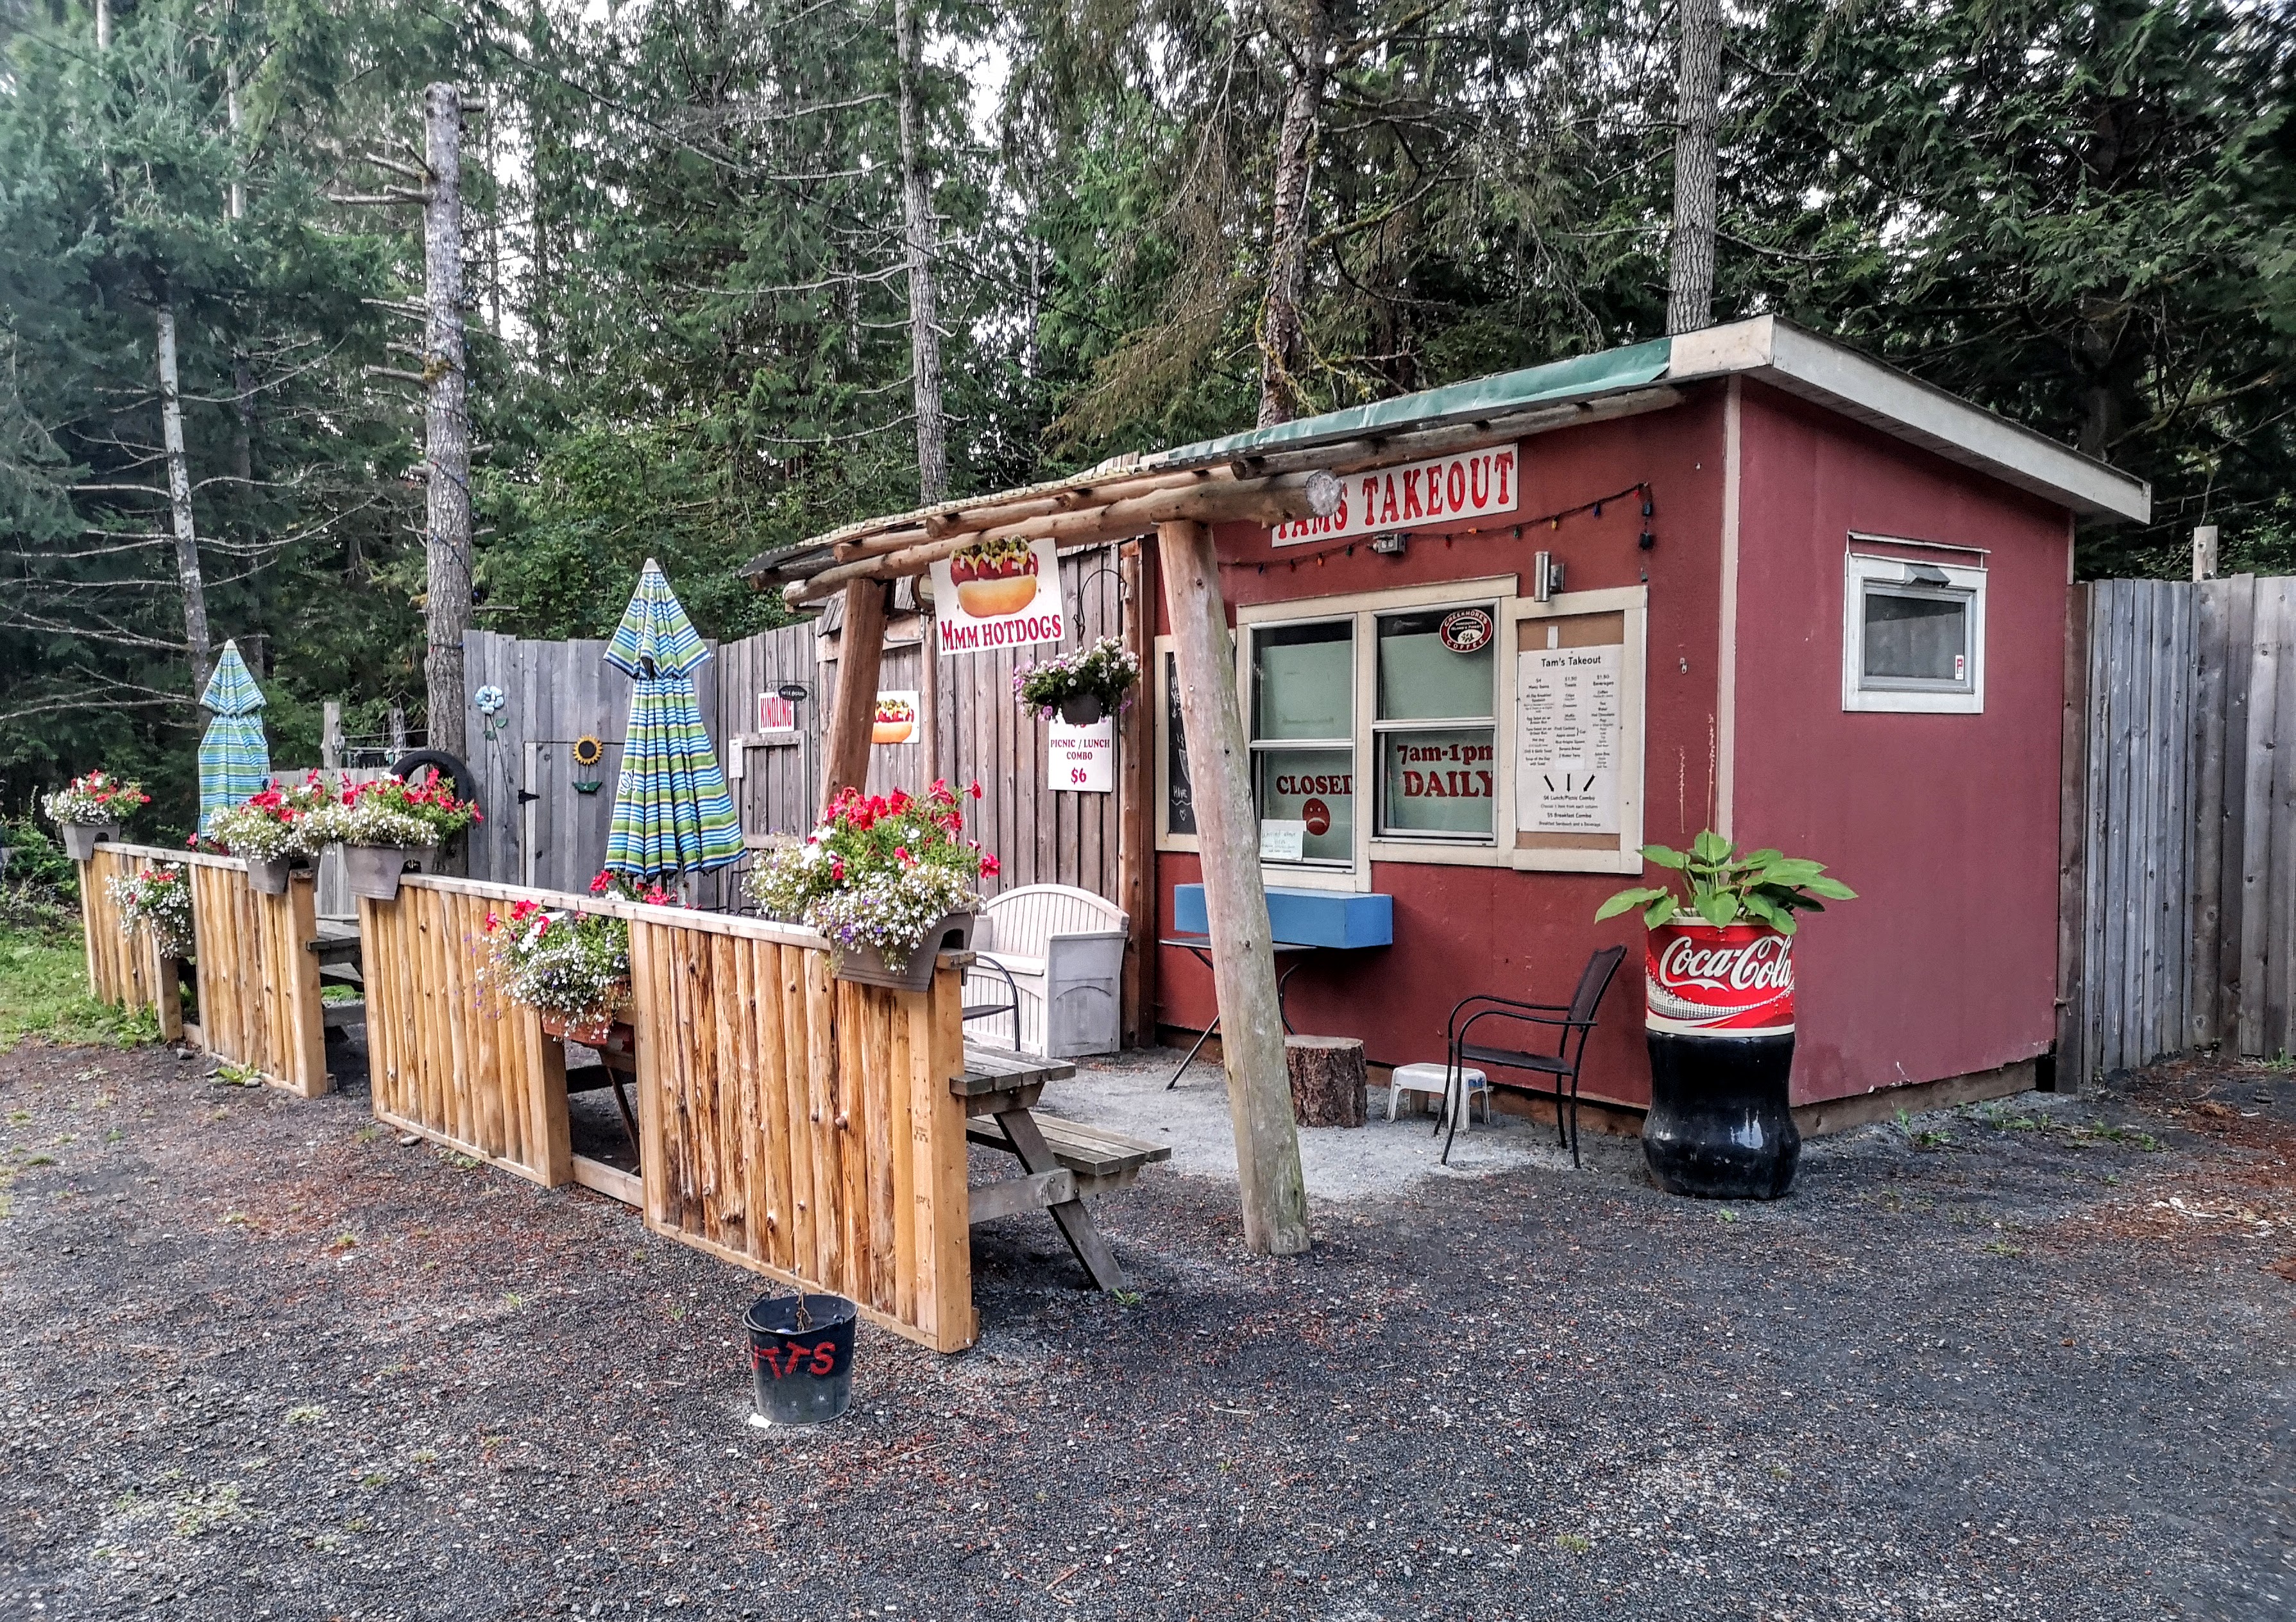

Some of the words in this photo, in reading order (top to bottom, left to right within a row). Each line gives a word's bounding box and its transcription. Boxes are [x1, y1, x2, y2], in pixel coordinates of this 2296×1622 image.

[1362, 451, 1514, 526] TAKEOUT
[982, 614, 1062, 646] HOTDOGS
[1447, 638, 1484, 650] COFFEE
[1541, 657, 1565, 667] Tam's
[1568, 655, 1601, 666] Takeout
[760, 697, 792, 729] KINDLING
[1050, 739, 1076, 748] PICNIC
[1084, 739, 1110, 748] LUNCH
[1066, 751, 1093, 760] COMBO
[1397, 744, 1493, 765] 7am-1pm
[1071, 767, 1087, 784] $6
[1402, 770, 1493, 797] DAILY
[1659, 935, 1794, 992] Coca-Cola
